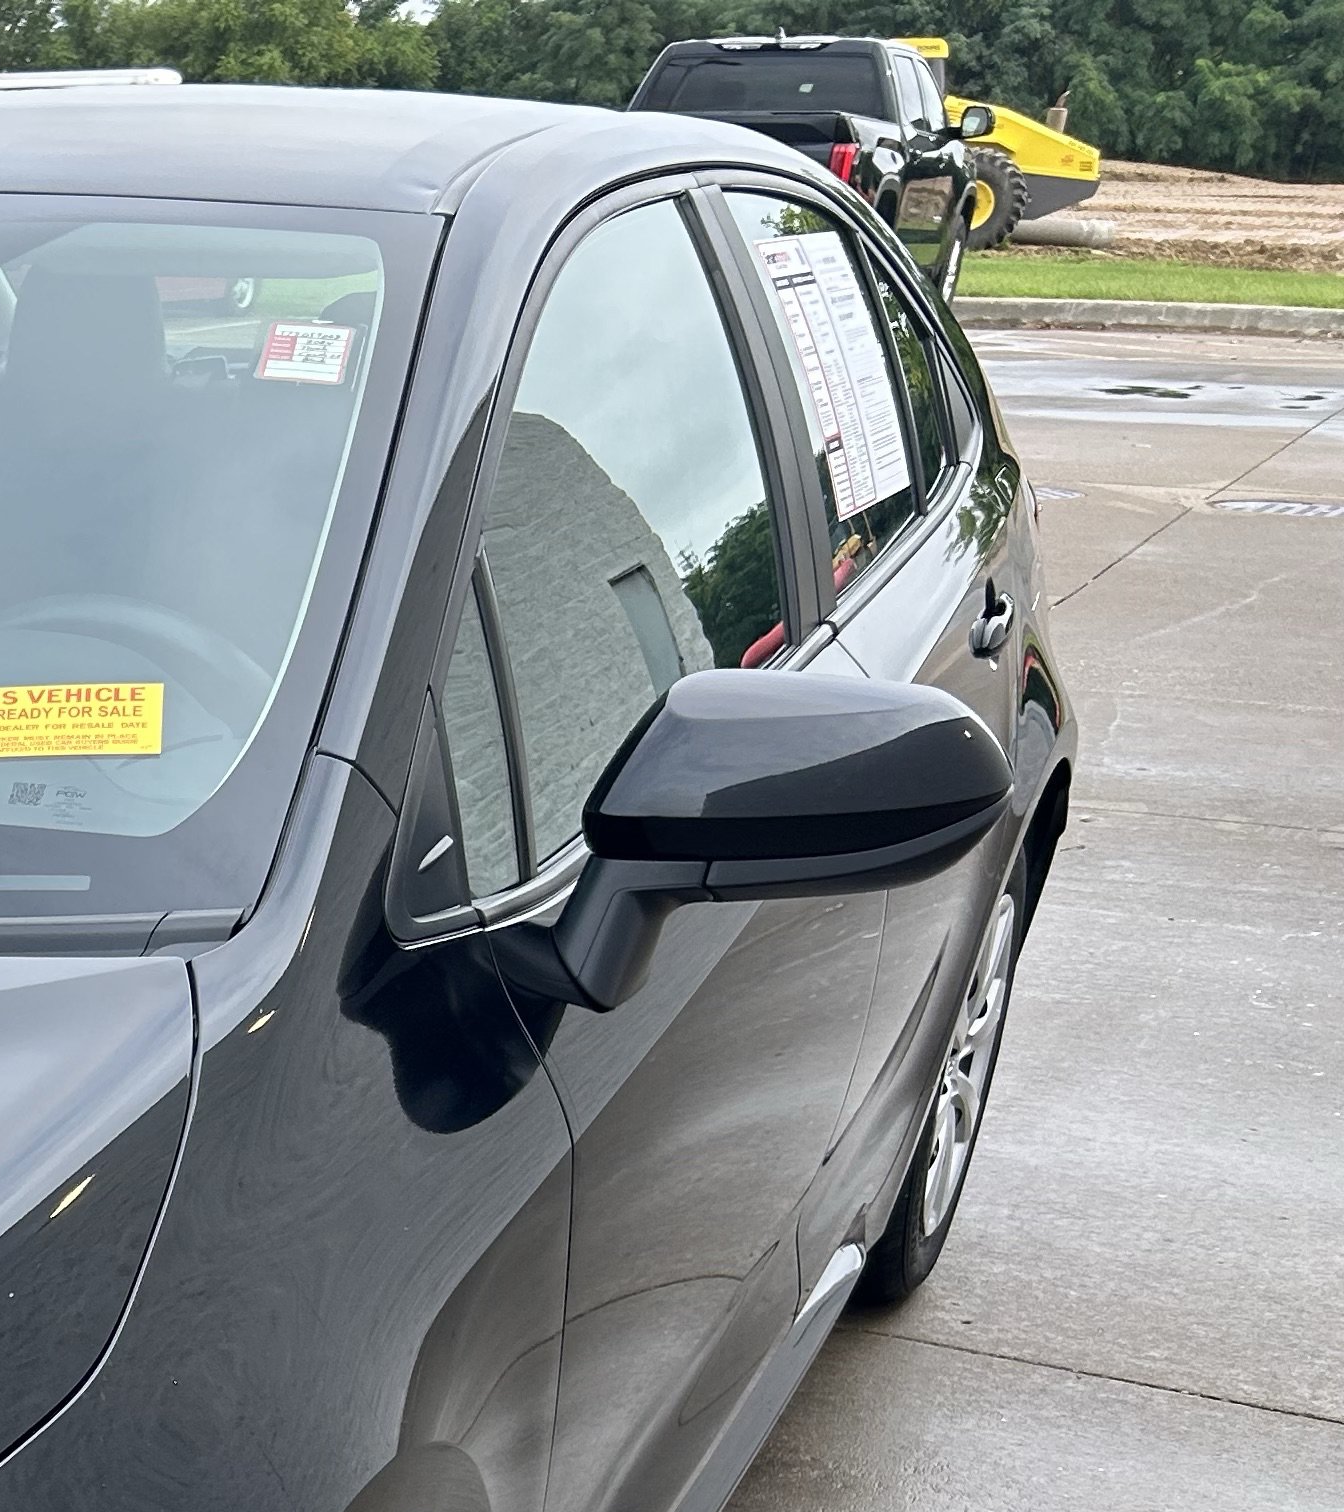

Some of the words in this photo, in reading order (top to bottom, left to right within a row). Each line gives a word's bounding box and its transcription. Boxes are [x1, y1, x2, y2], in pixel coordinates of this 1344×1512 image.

[27, 687, 146, 704] VEHICLE
[58, 706, 93, 718] FOR
[98, 705, 143, 717] SALE
